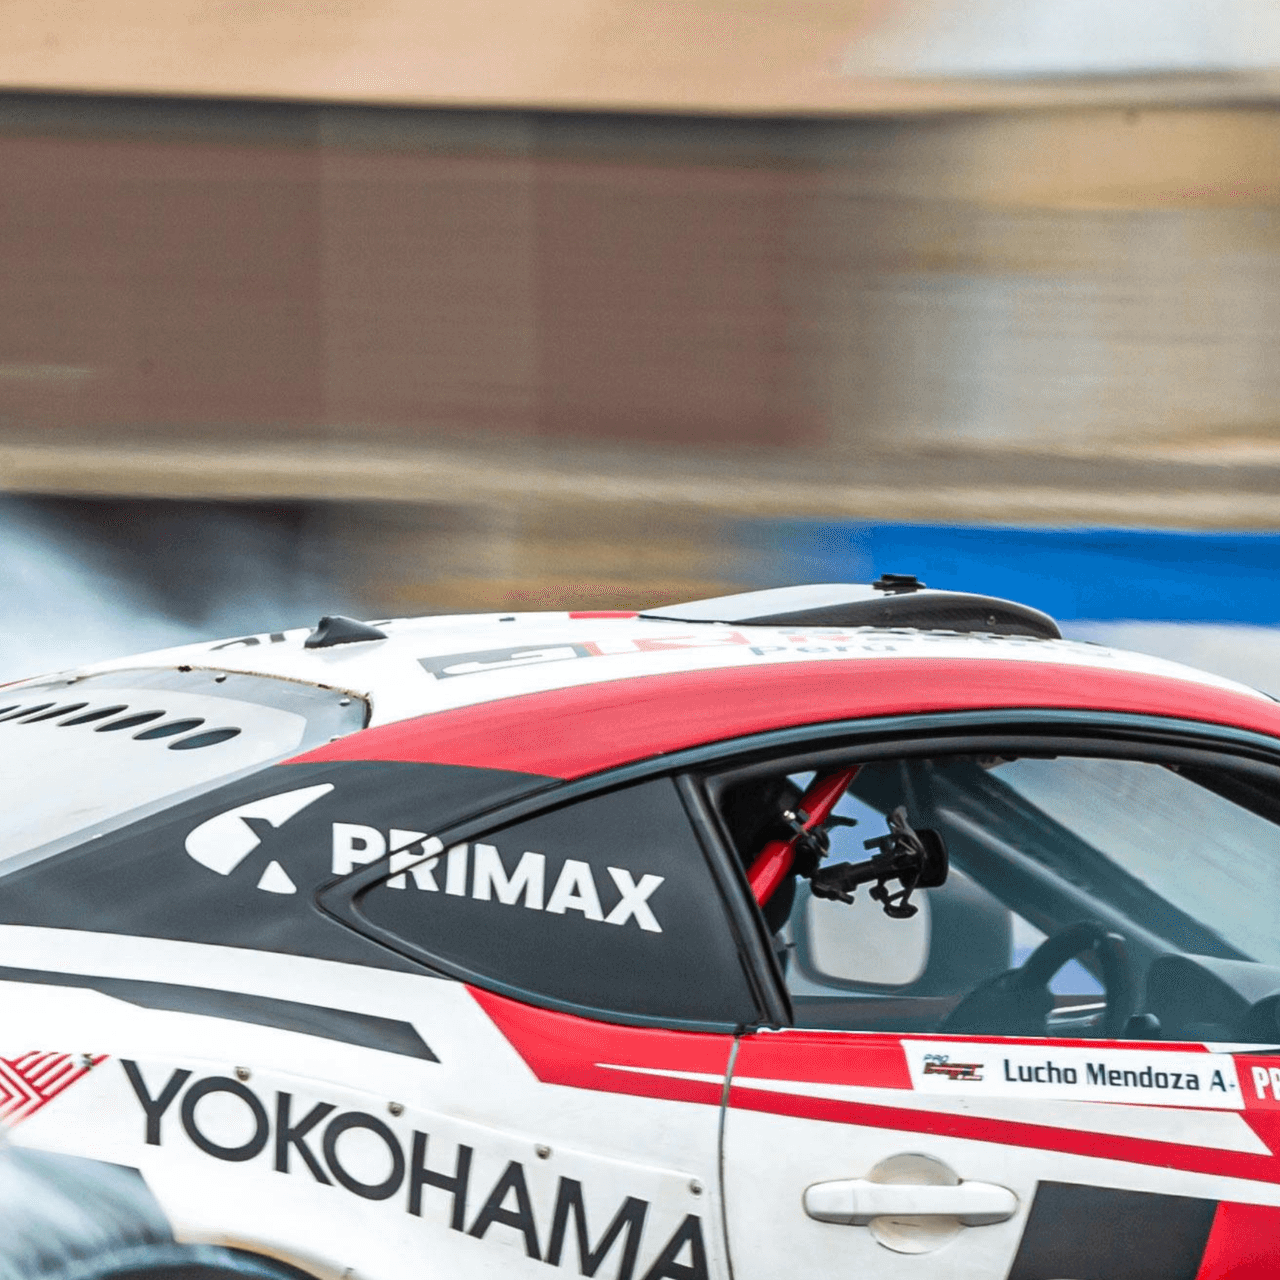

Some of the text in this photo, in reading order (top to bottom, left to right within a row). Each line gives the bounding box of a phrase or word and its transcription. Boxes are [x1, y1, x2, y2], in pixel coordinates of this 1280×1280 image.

[332, 822, 665, 934] PRIMAX
[1004, 1058, 1077, 1085] Lucho
[1086, 1063, 1200, 1091] Mendoza
